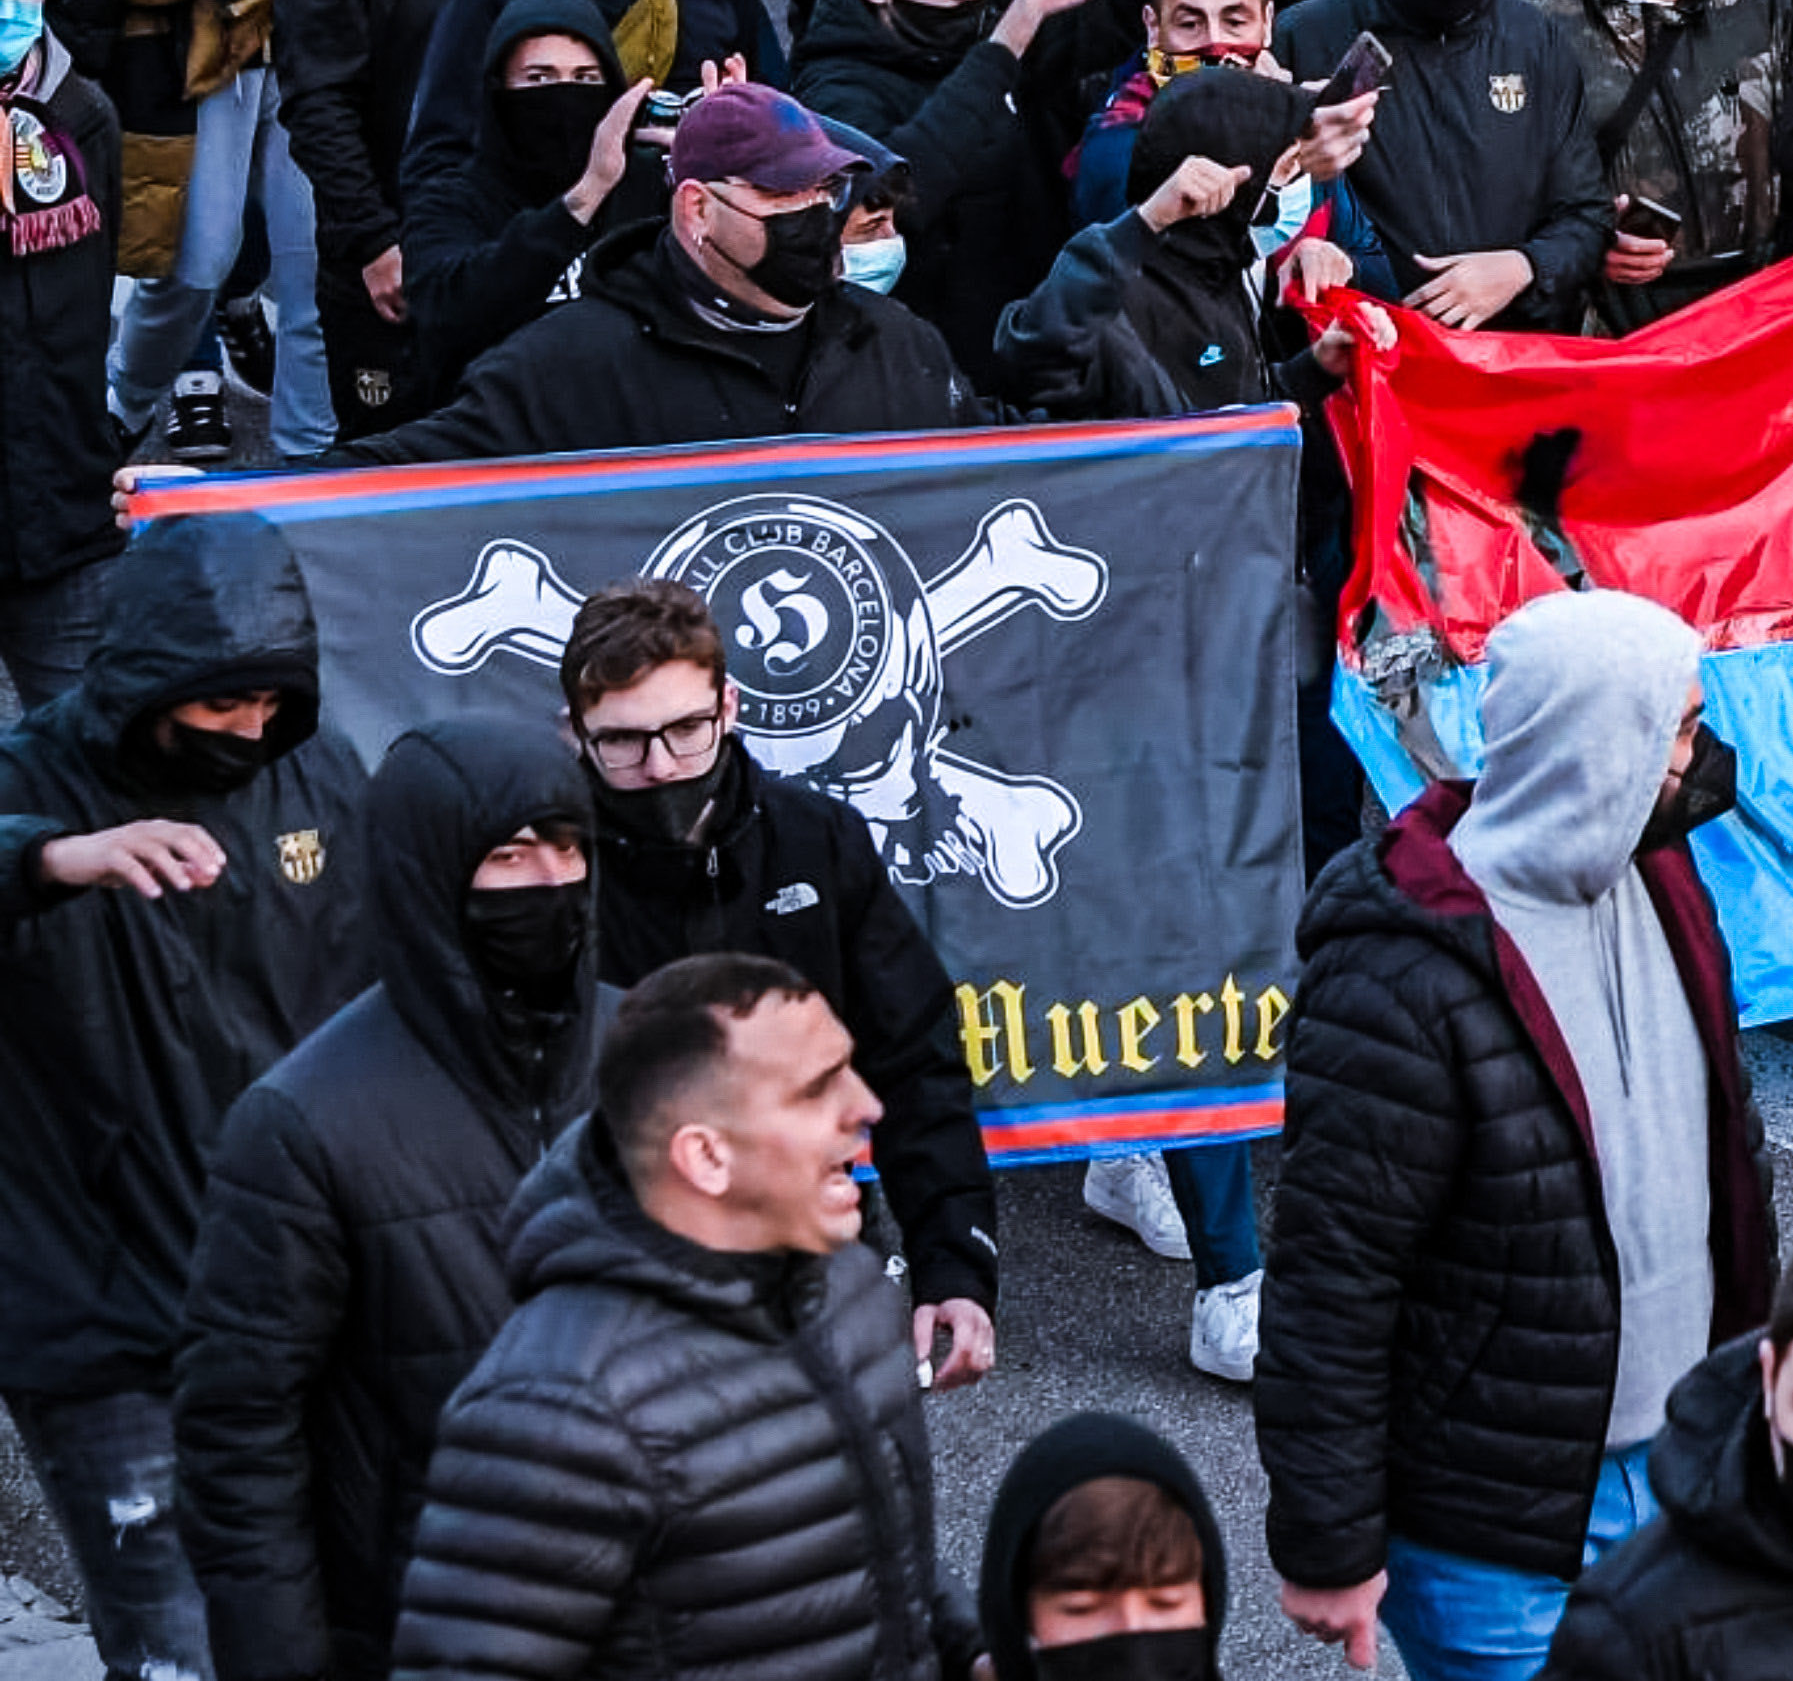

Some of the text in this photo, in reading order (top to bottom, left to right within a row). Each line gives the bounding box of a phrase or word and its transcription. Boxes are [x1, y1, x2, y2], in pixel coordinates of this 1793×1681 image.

[723, 524, 803, 556] CLUB
[810, 530, 880, 698] BARCELONA
[759, 697, 821, 726] 1899
